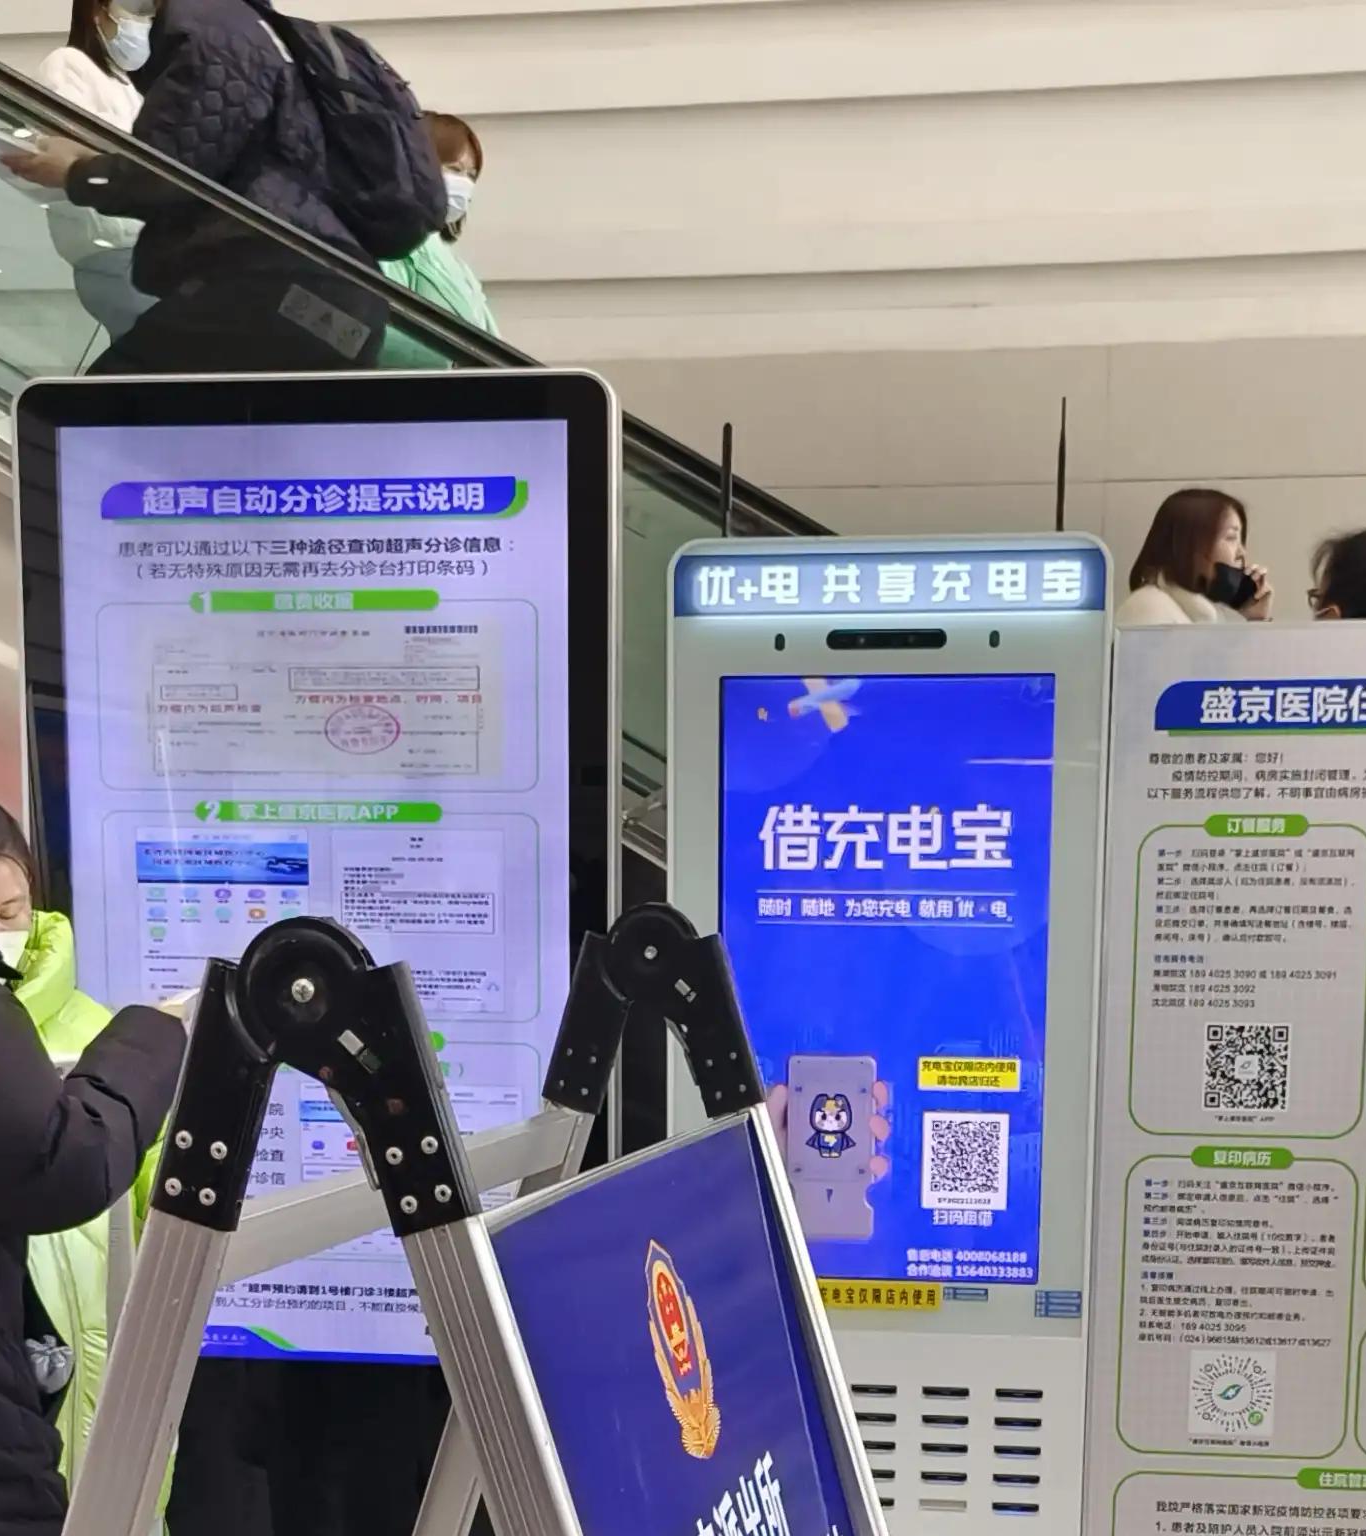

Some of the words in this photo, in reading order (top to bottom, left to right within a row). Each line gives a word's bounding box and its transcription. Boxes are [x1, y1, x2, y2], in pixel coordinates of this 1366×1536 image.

[142, 483, 485, 515] 超声自动分诊提示说明
[822, 560, 1084, 604] 共享充电宝
[758, 803, 1014, 872] 借充电宝
[1213, 1150, 1272, 1167] 复印病历
